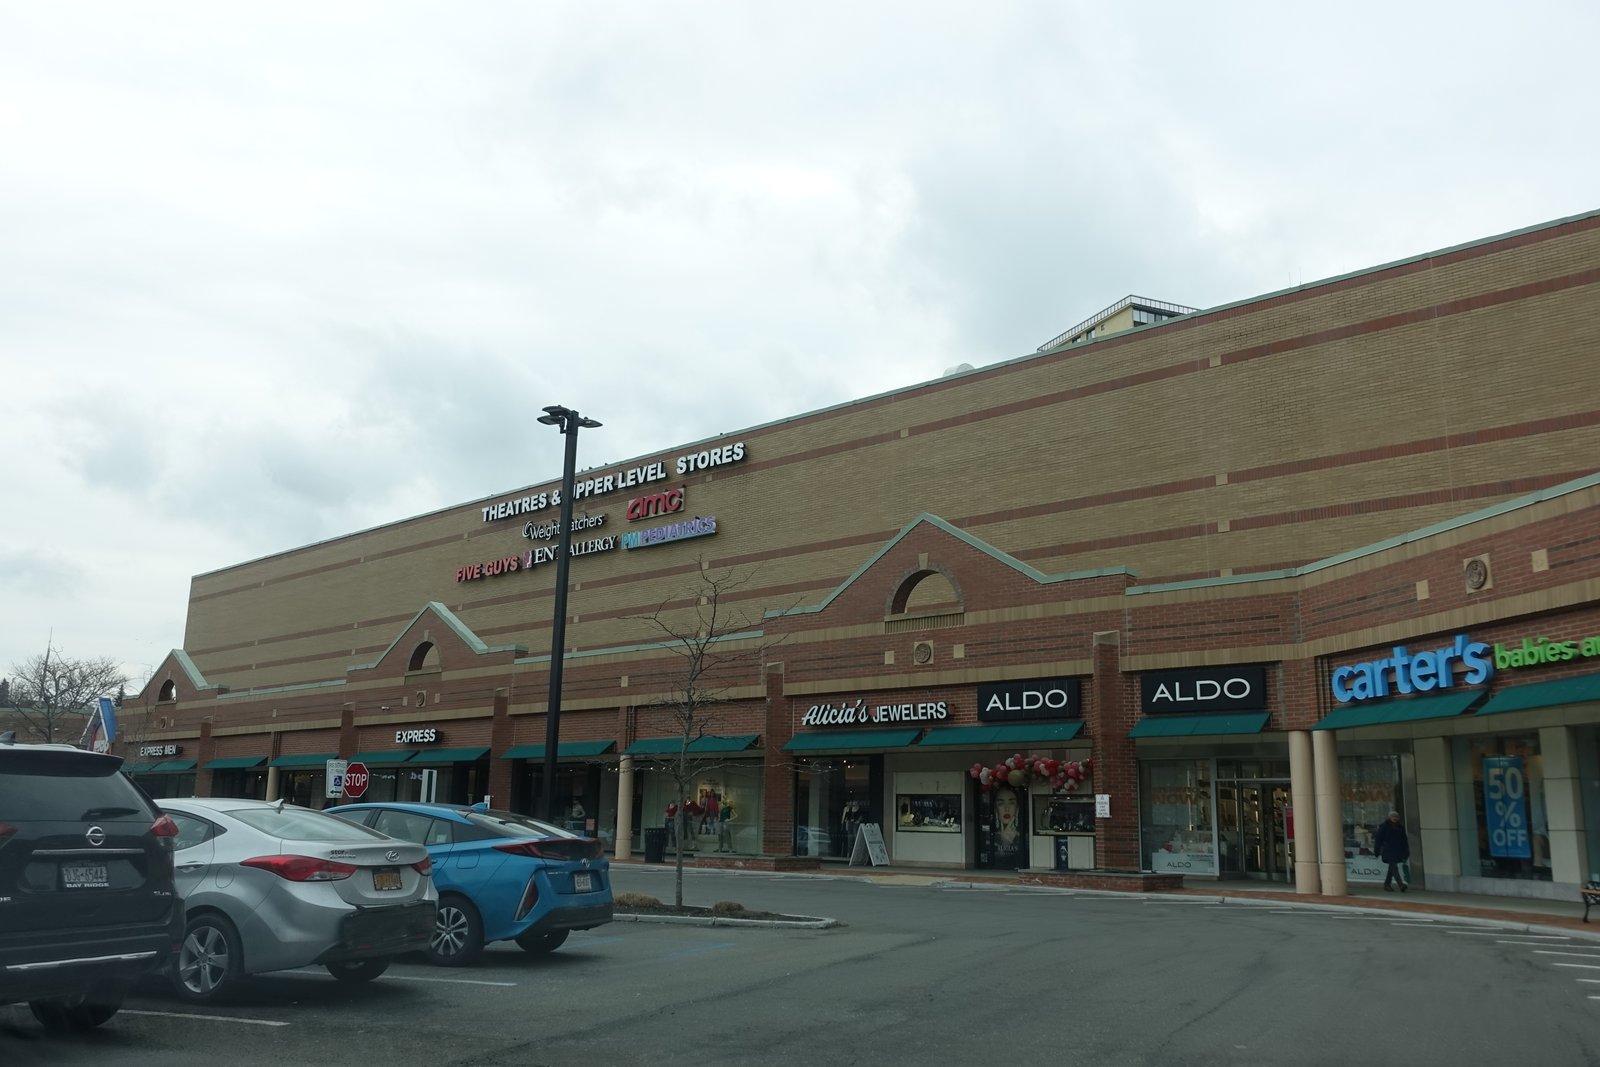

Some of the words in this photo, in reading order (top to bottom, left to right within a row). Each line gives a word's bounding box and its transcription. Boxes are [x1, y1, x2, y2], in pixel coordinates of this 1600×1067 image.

[481, 492, 548, 522] THEATRES
[551, 489, 561, 506] &
[573, 474, 614, 499] PPER
[618, 462, 666, 488] LEVEL
[676, 442, 745, 474] STORES
[571, 514, 603, 531] atchers
[621, 531, 640, 550] PM
[640, 515, 717, 543] PEDIATRICS
[570, 535, 618, 556] ALLERGY
[455, 564, 481, 582] FIVE
[484, 556, 520, 577] GUYS
[1332, 635, 1494, 703] carter's
[1494, 636, 1577, 670] babies
[985, 688, 1069, 712] ALDO
[1151, 677, 1251, 703] ALDO
[801, 699, 869, 726] Alicia's
[872, 701, 948, 723] JEWELERS
[395, 728, 437, 744] EXPRESS
[140, 746, 163, 756] EXPRESS
[164, 744, 177, 755] MEN
[345, 773, 367, 787] STOP
[1488, 767, 1523, 799] 50
[1495, 801, 1521, 828] %
[1493, 829, 1528, 847] OFF
[1166, 860, 1192, 869] ALDO
[1351, 867, 1382, 877] ALDO
